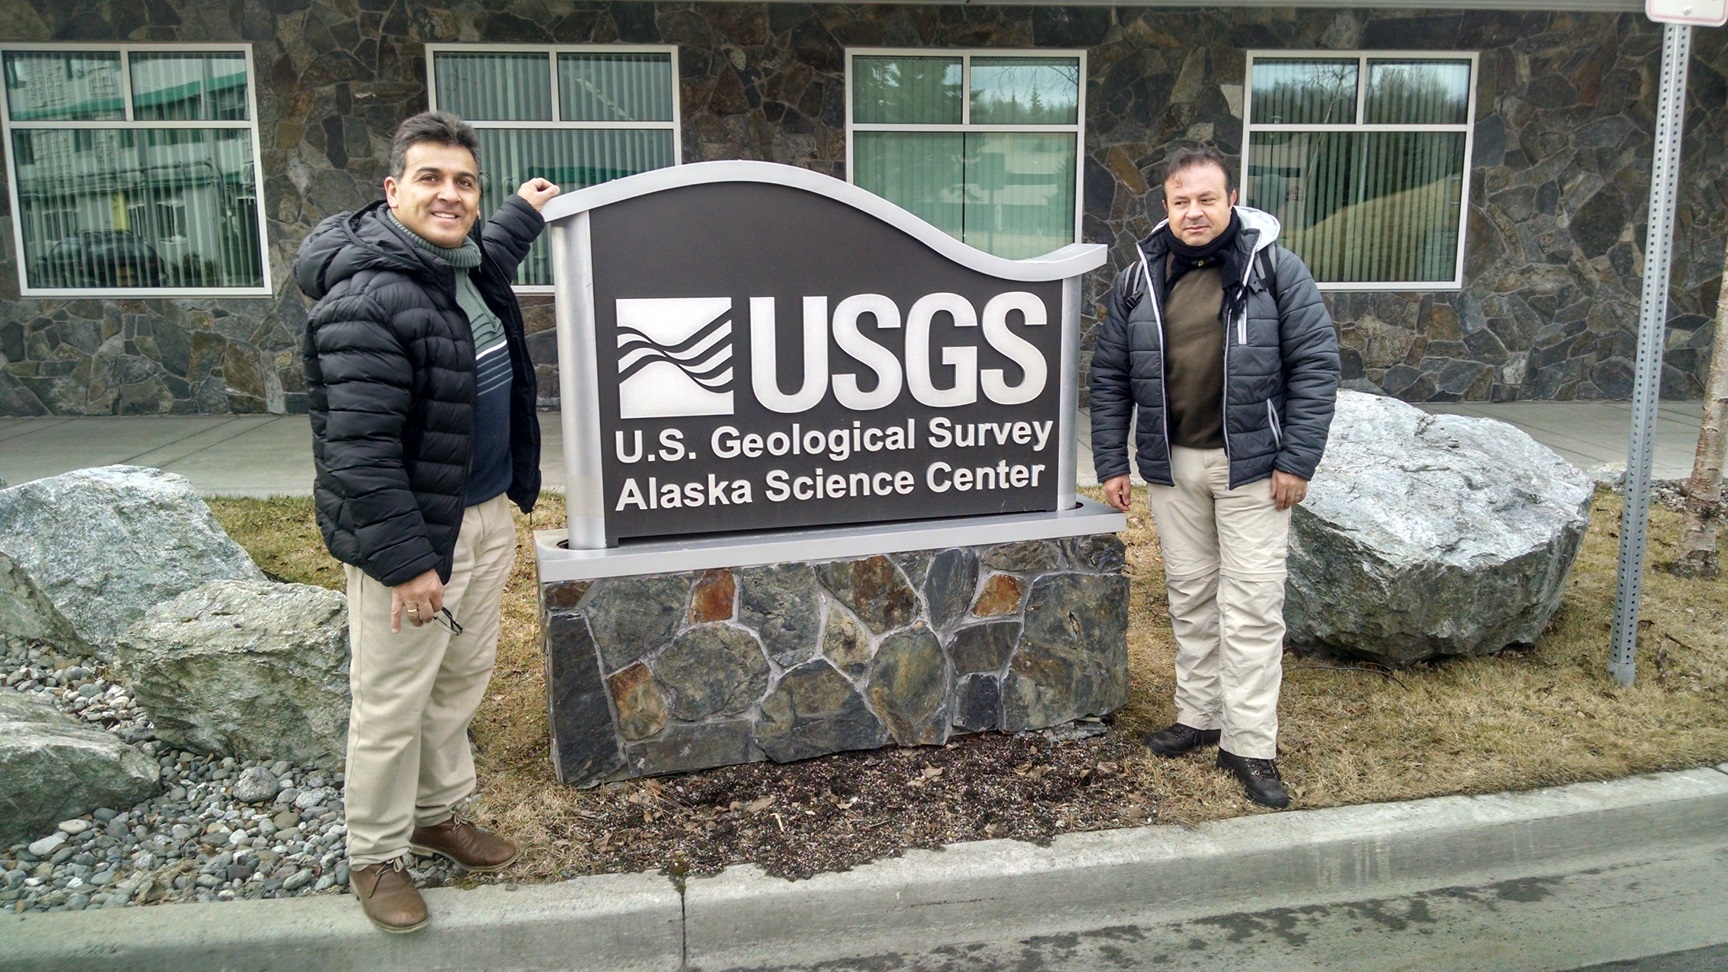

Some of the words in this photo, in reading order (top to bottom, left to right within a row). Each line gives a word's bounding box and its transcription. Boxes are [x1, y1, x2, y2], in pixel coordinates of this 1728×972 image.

[749, 291, 1048, 414] USGS
[615, 429, 697, 462] U.S.
[710, 418, 915, 462] Geological
[928, 416, 1054, 453] Survey
[615, 473, 753, 512] Alaska
[765, 467, 915, 502] Science
[926, 459, 1046, 493] Center
